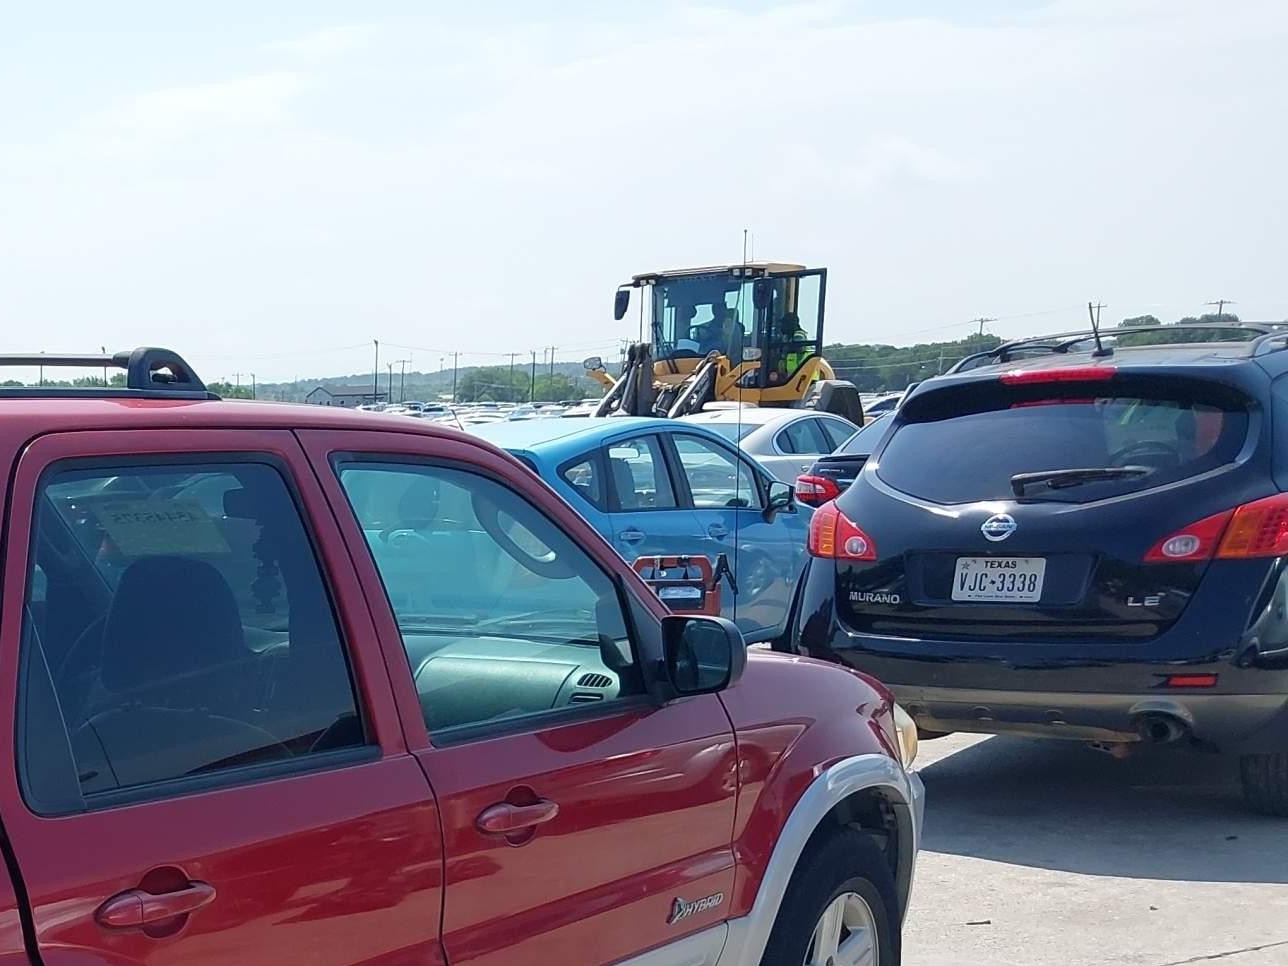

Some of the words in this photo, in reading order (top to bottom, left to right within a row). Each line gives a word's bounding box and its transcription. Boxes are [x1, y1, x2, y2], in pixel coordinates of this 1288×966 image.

[984, 560, 1017, 569] TEXAS
[848, 591, 901, 605] MURANO
[1127, 596, 1161, 607] LE
[684, 893, 724, 918] HYBRID
